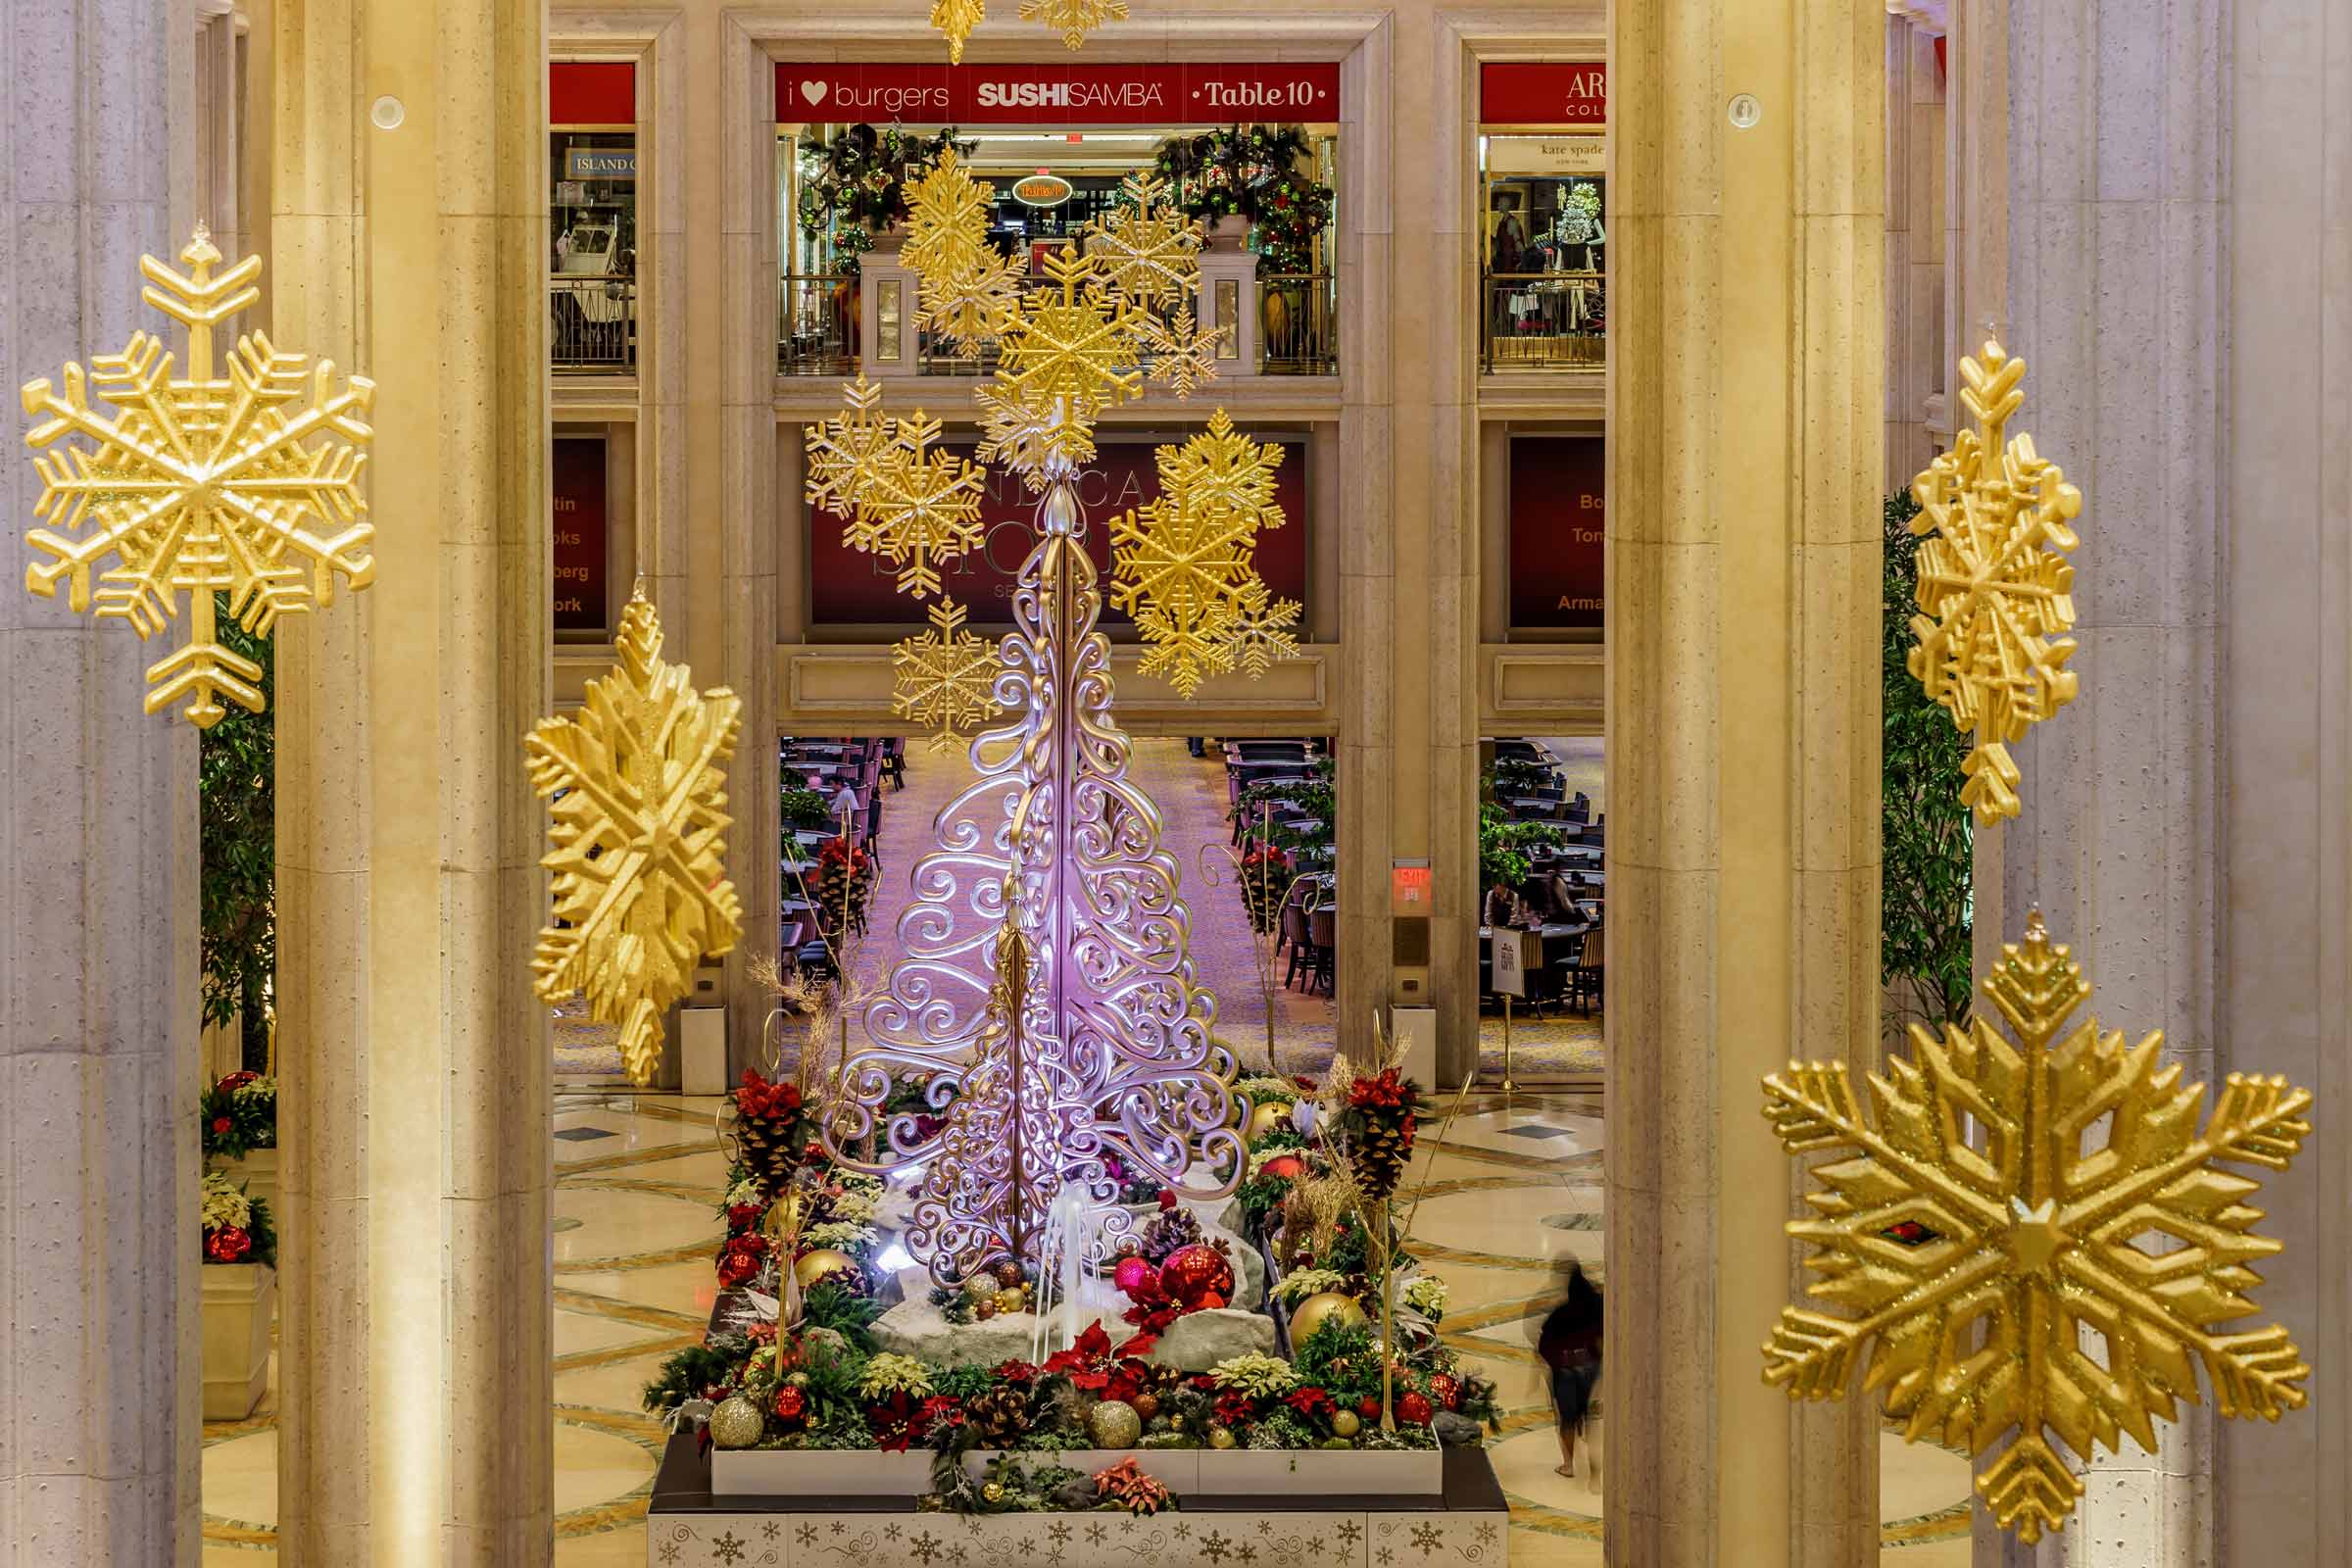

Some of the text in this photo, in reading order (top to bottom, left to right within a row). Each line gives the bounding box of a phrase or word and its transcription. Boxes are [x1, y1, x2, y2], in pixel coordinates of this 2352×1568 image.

[836, 82, 949, 112] burgers
[1204, 81, 1313, 106] Table 10
[1566, 104, 1605, 116] COL
[1542, 145, 1604, 157] kate spade
[577, 157, 627, 171] ISLAND
